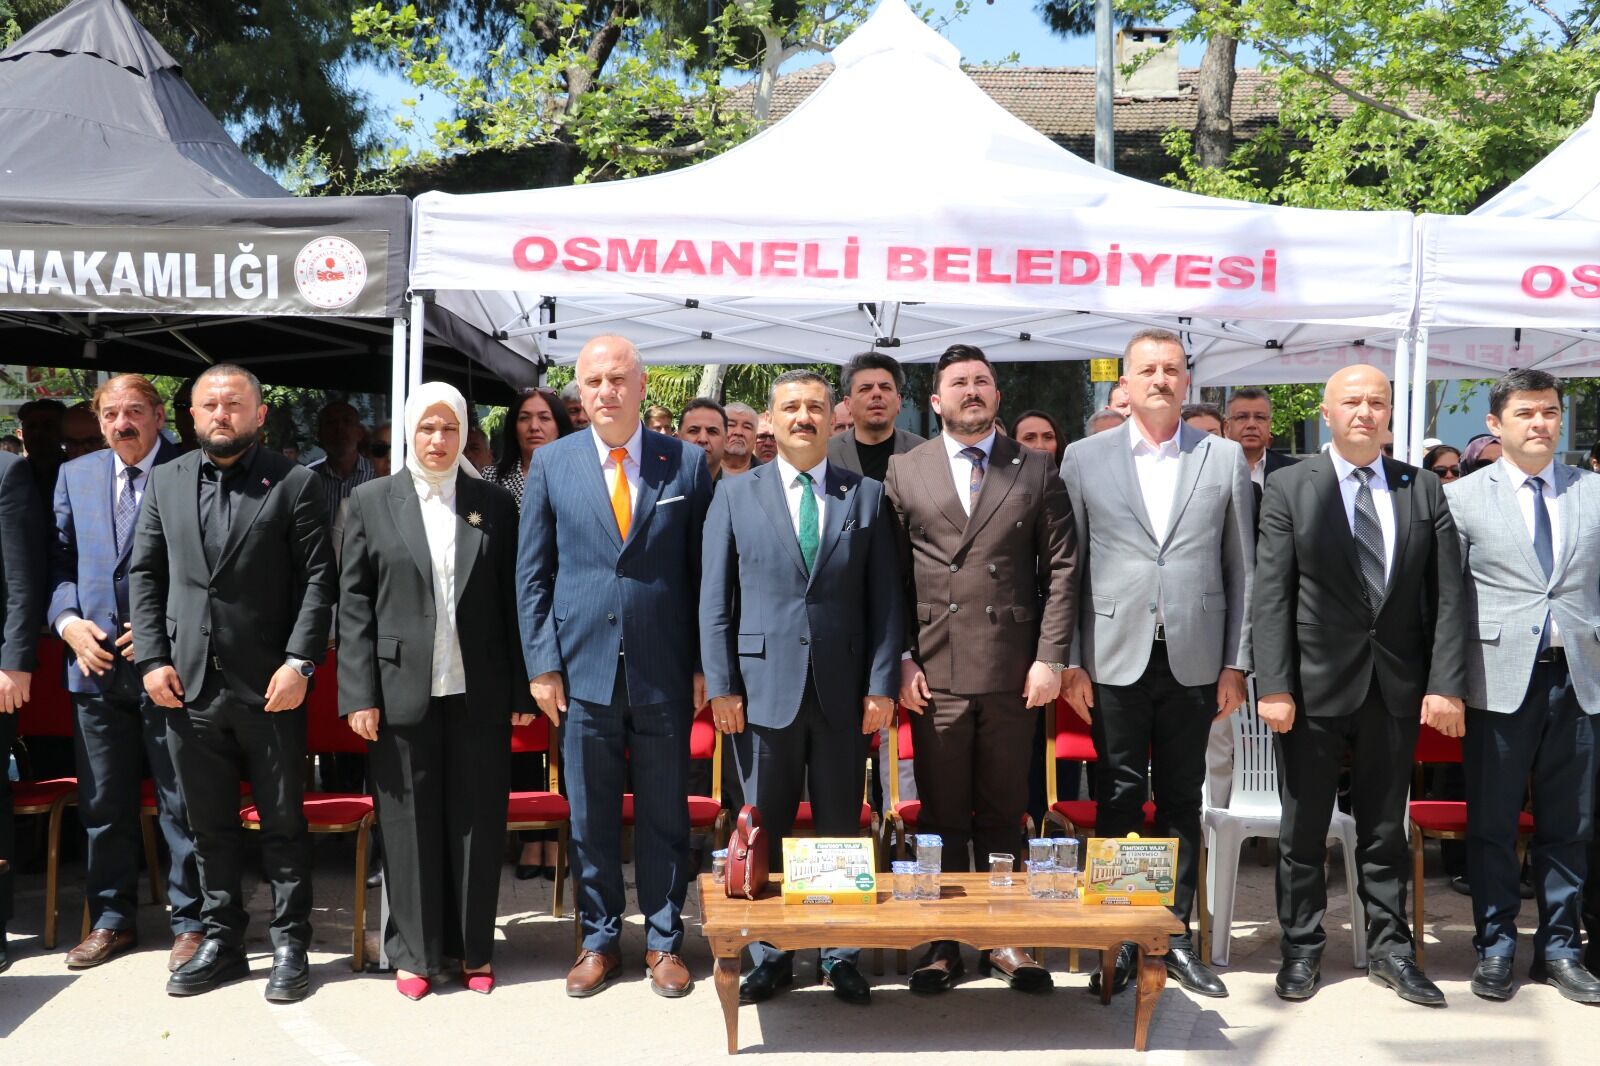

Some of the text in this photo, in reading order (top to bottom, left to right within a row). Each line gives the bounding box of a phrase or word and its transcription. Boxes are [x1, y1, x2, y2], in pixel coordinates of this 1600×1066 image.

[0, 242, 278, 299] MAKAMLIĞI
[512, 235, 1277, 293] OSMANELİ BELEDİYESİ
[1521, 264, 1600, 298] OS
